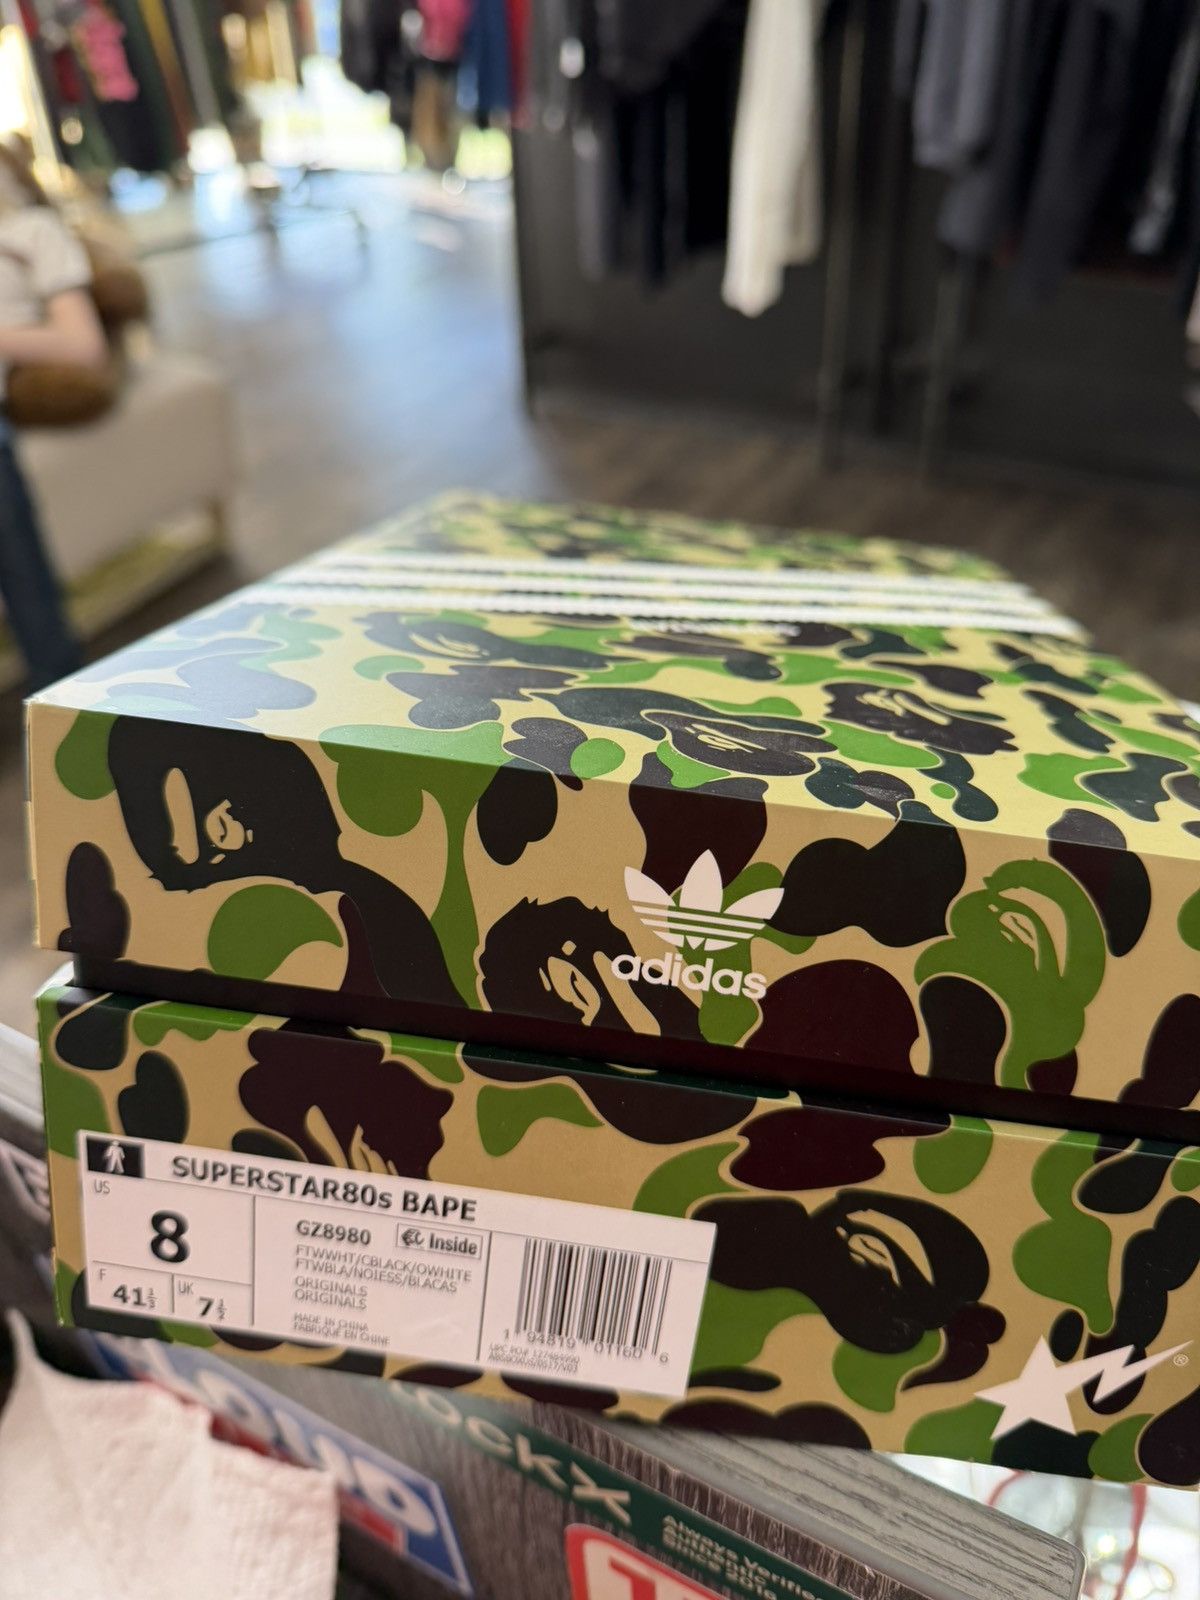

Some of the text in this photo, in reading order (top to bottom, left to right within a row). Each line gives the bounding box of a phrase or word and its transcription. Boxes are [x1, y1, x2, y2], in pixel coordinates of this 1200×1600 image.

[611, 951, 768, 1000] adidas
[94, 1179, 111, 1194] US
[172, 1155, 478, 1222] SUPERSTAR80s BAPE
[150, 1209, 191, 1263] 8
[296, 1219, 372, 1246] GZ8980
[429, 1232, 478, 1256] Inside
[99, 1268, 107, 1280] F
[296, 1244, 472, 1282] FTWWHT/CBLACK/OWHITE
[178, 1280, 194, 1295] UK
[294, 1275, 368, 1297] ORIGINALS
[294, 1288, 368, 1310] ORIGINALS
[293, 1321, 341, 1338] FABRIQUE
[344, 1328, 357, 1339] EN
[294, 1312, 369, 1331] MADE IN CHINA
[503, 1328, 510, 1340] 1
[527, 1331, 577, 1350] 94819
[660, 1352, 669, 1364] 6
[662, 1515, 739, 1562] Always
[743, 1555, 824, 1600] Verifie
